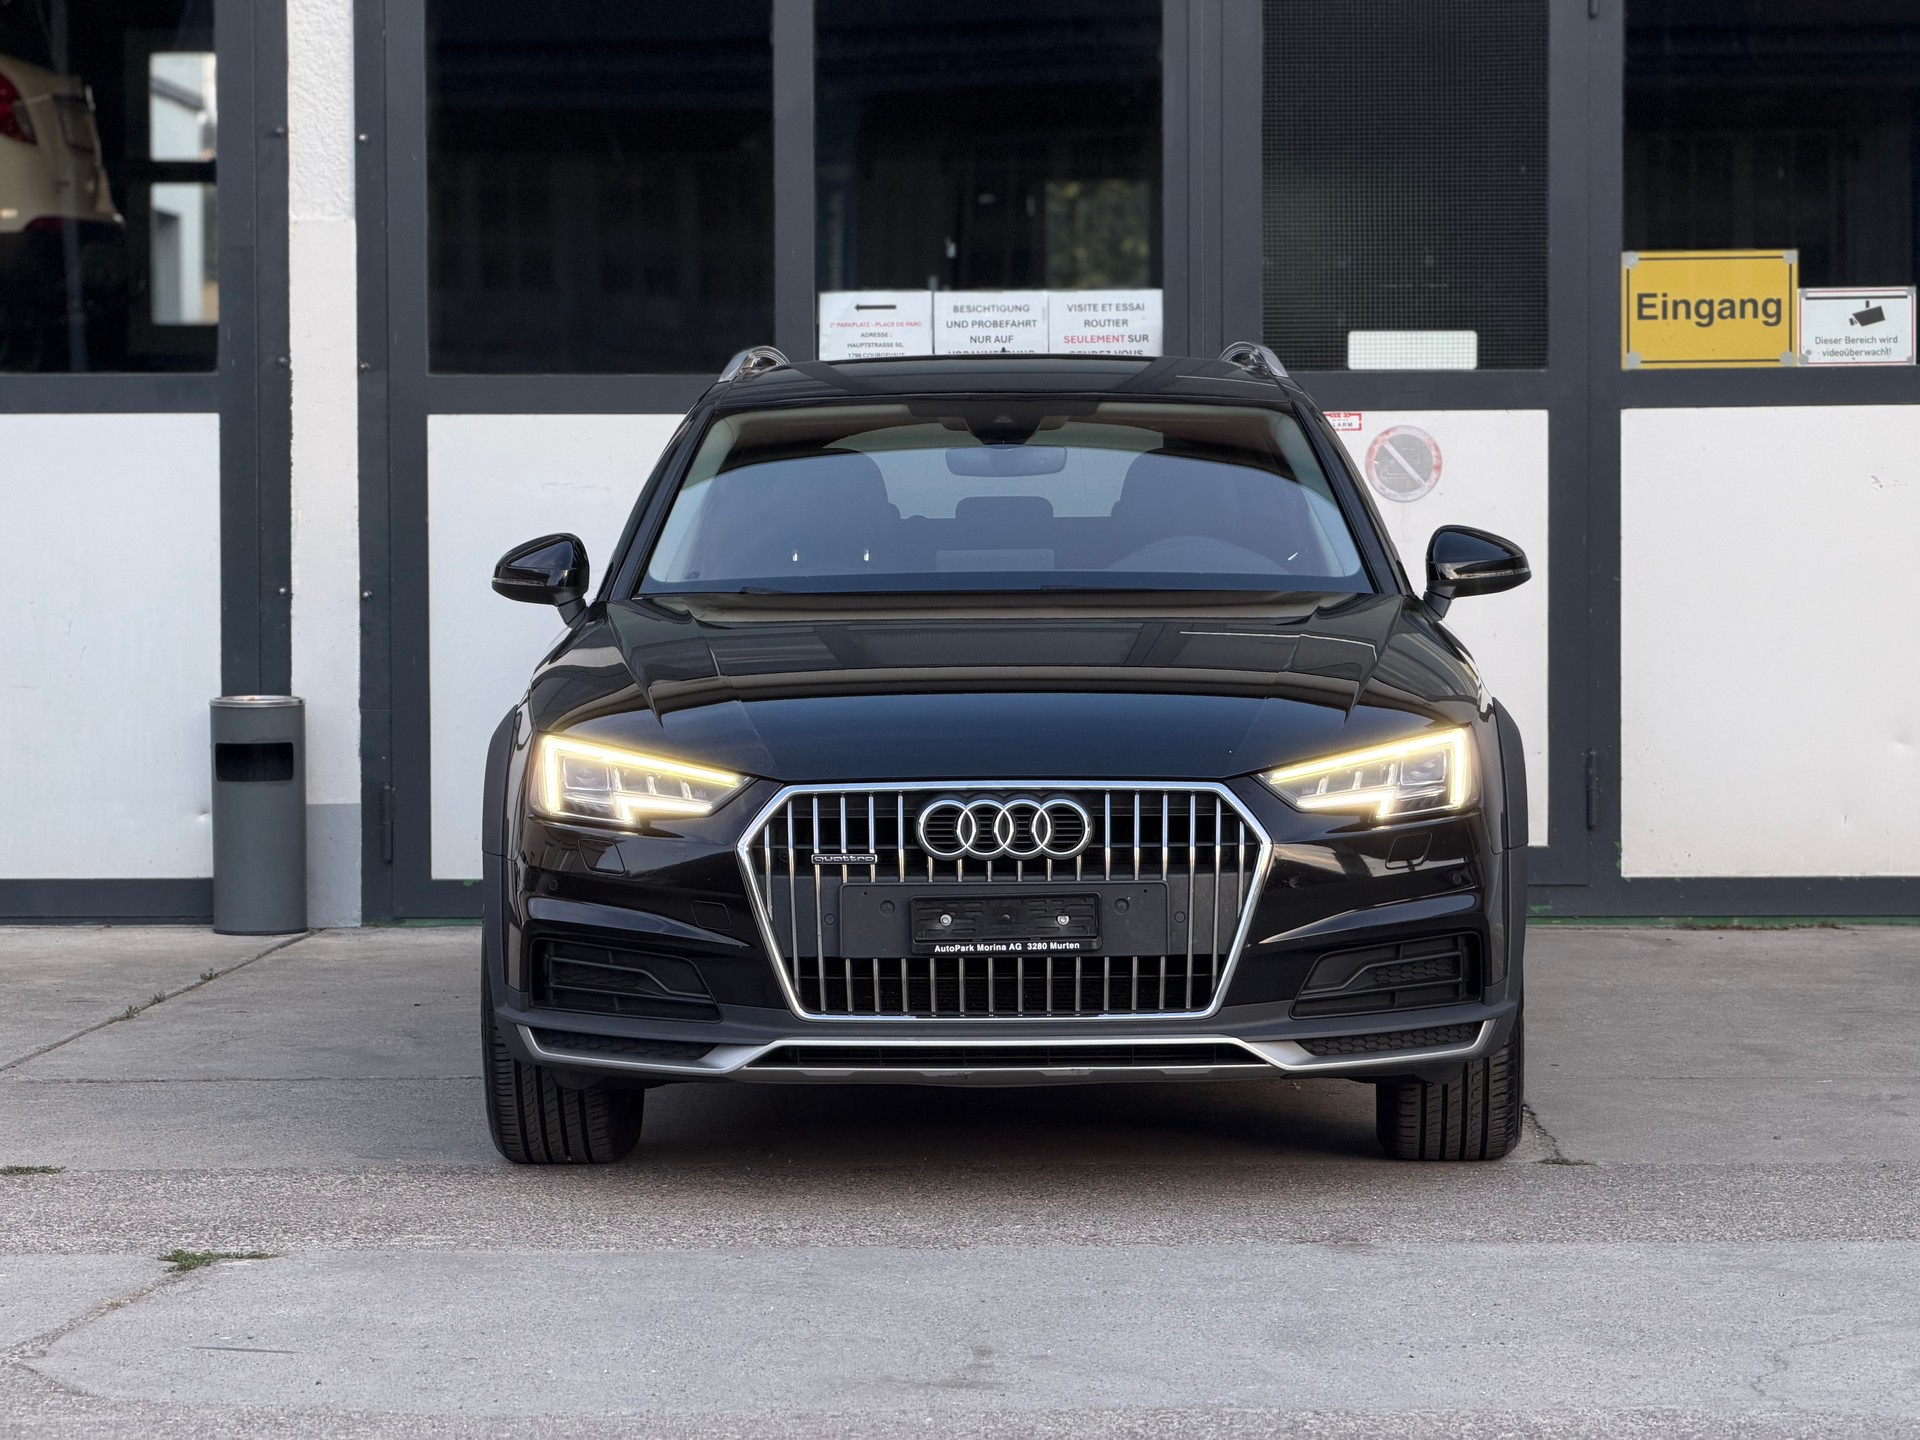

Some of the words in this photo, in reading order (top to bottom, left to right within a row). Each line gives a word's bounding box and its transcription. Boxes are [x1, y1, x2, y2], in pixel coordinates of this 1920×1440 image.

[953, 304, 1030, 313] BESICHTIGUNG
[1066, 303, 1099, 312] VISITE
[1101, 303, 1113, 312] ET
[1115, 302, 1145, 311] ESSAI
[1636, 292, 1782, 327] Eingang
[946, 320, 969, 329] UND
[971, 319, 1038, 328] PROBEFAHRT
[1083, 318, 1129, 328] ROUTIER
[969, 335, 992, 344] NUR
[993, 335, 1014, 343] AUF
[1063, 334, 1126, 344] SEULEMENT
[1127, 334, 1149, 343] SUR
[1815, 336, 1842, 345] Dieser
[1844, 335, 1877, 344] Bereich
[1878, 335, 1898, 344] wird
[1822, 347, 1892, 357] videoüberwacht!
[814, 855, 875, 863] quattro
[934, 944, 975, 953] AutoPark
[976, 943, 1007, 952] Morina
[1008, 943, 1022, 951] AG
[1026, 942, 1047, 950] 3280
[1049, 942, 1080, 950] Murten
